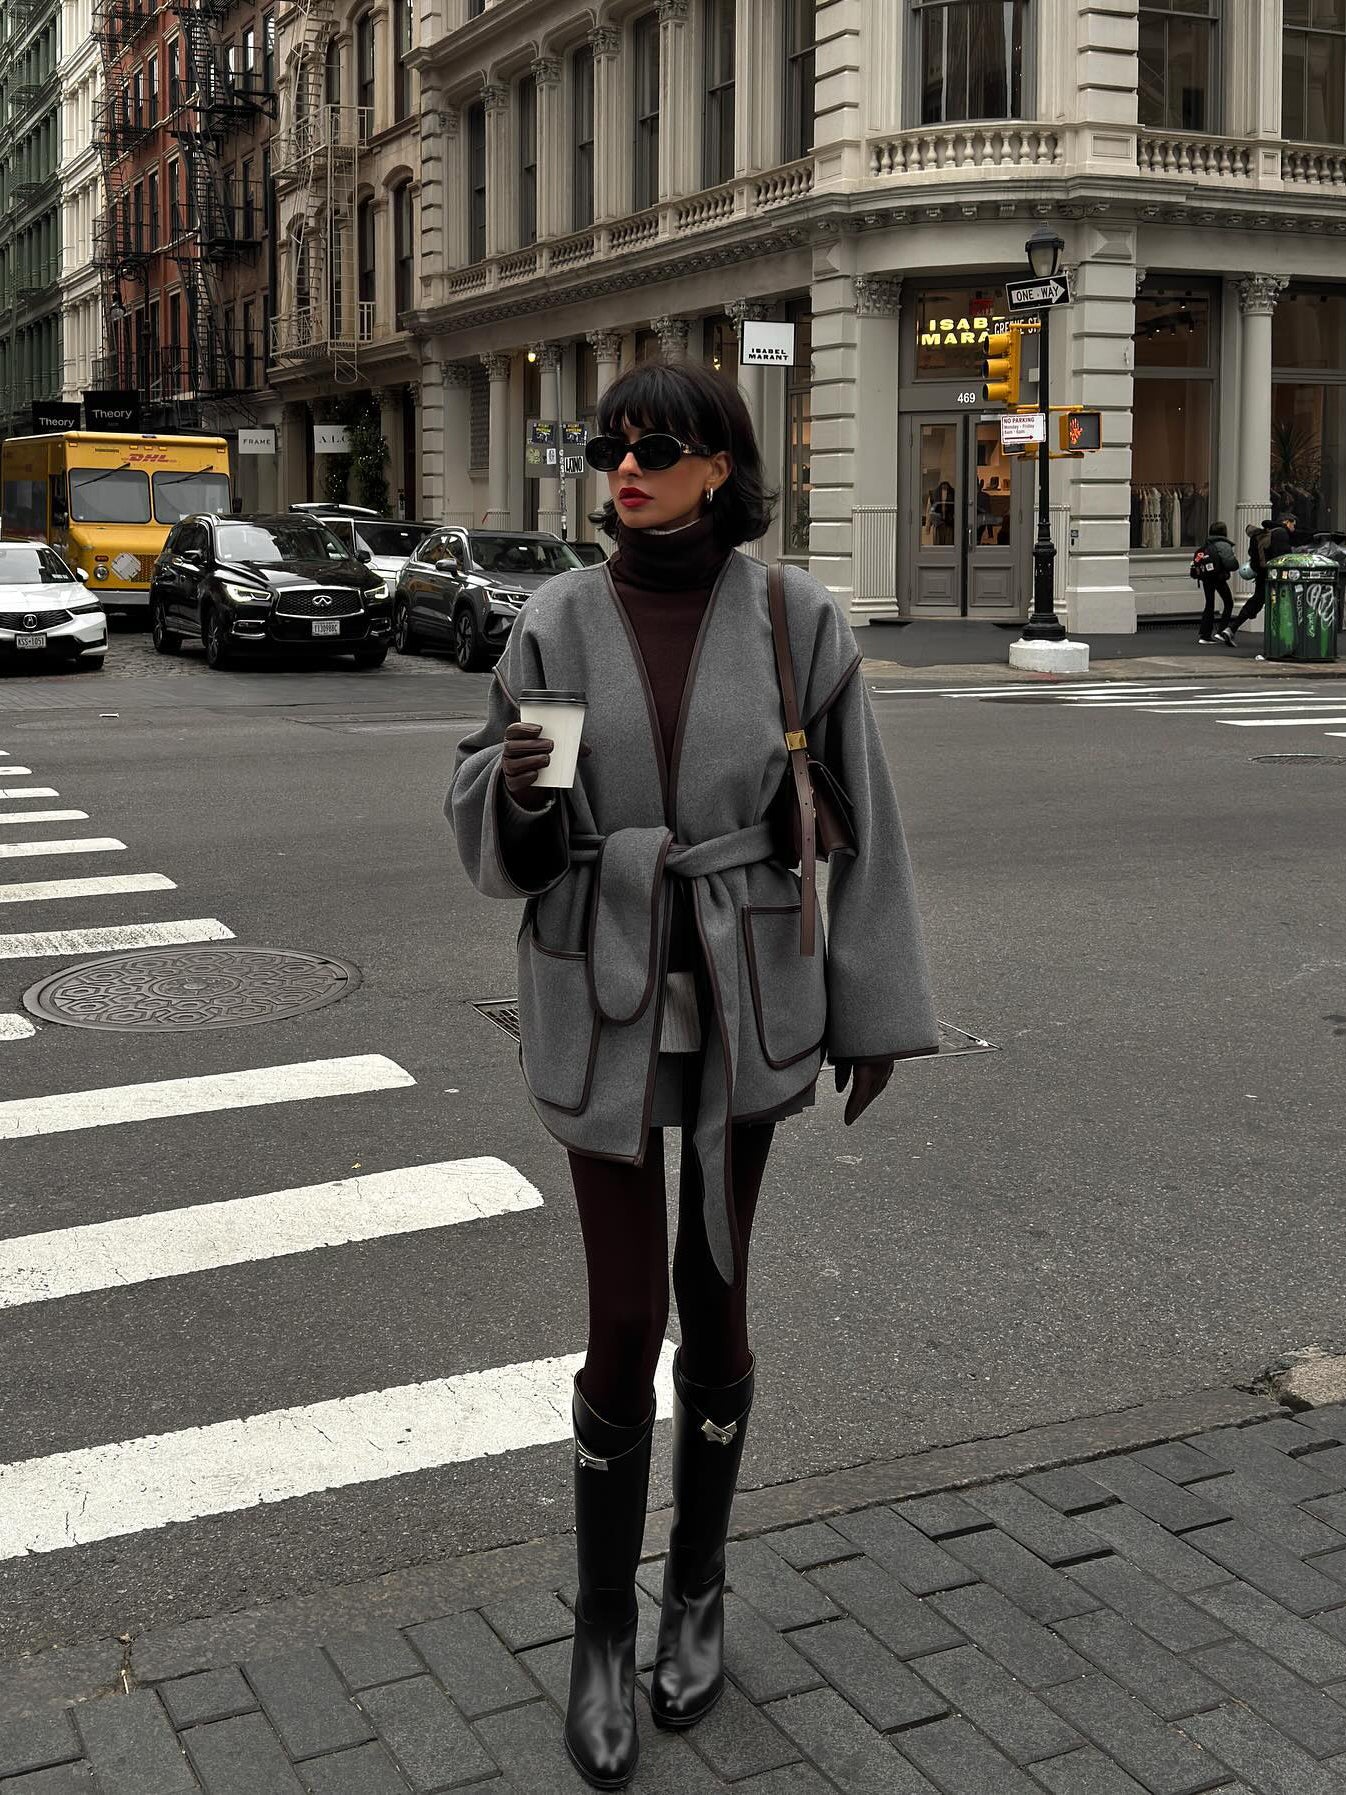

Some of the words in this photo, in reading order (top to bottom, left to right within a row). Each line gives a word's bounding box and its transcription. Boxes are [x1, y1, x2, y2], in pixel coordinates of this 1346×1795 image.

[1016, 289, 1034, 301] ONE
[1040, 286, 1059, 298] WAY
[957, 392, 976, 404] 469
[92, 408, 132, 420] Theory
[38, 417, 75, 428] Theory
[128, 453, 169, 463] DHL
